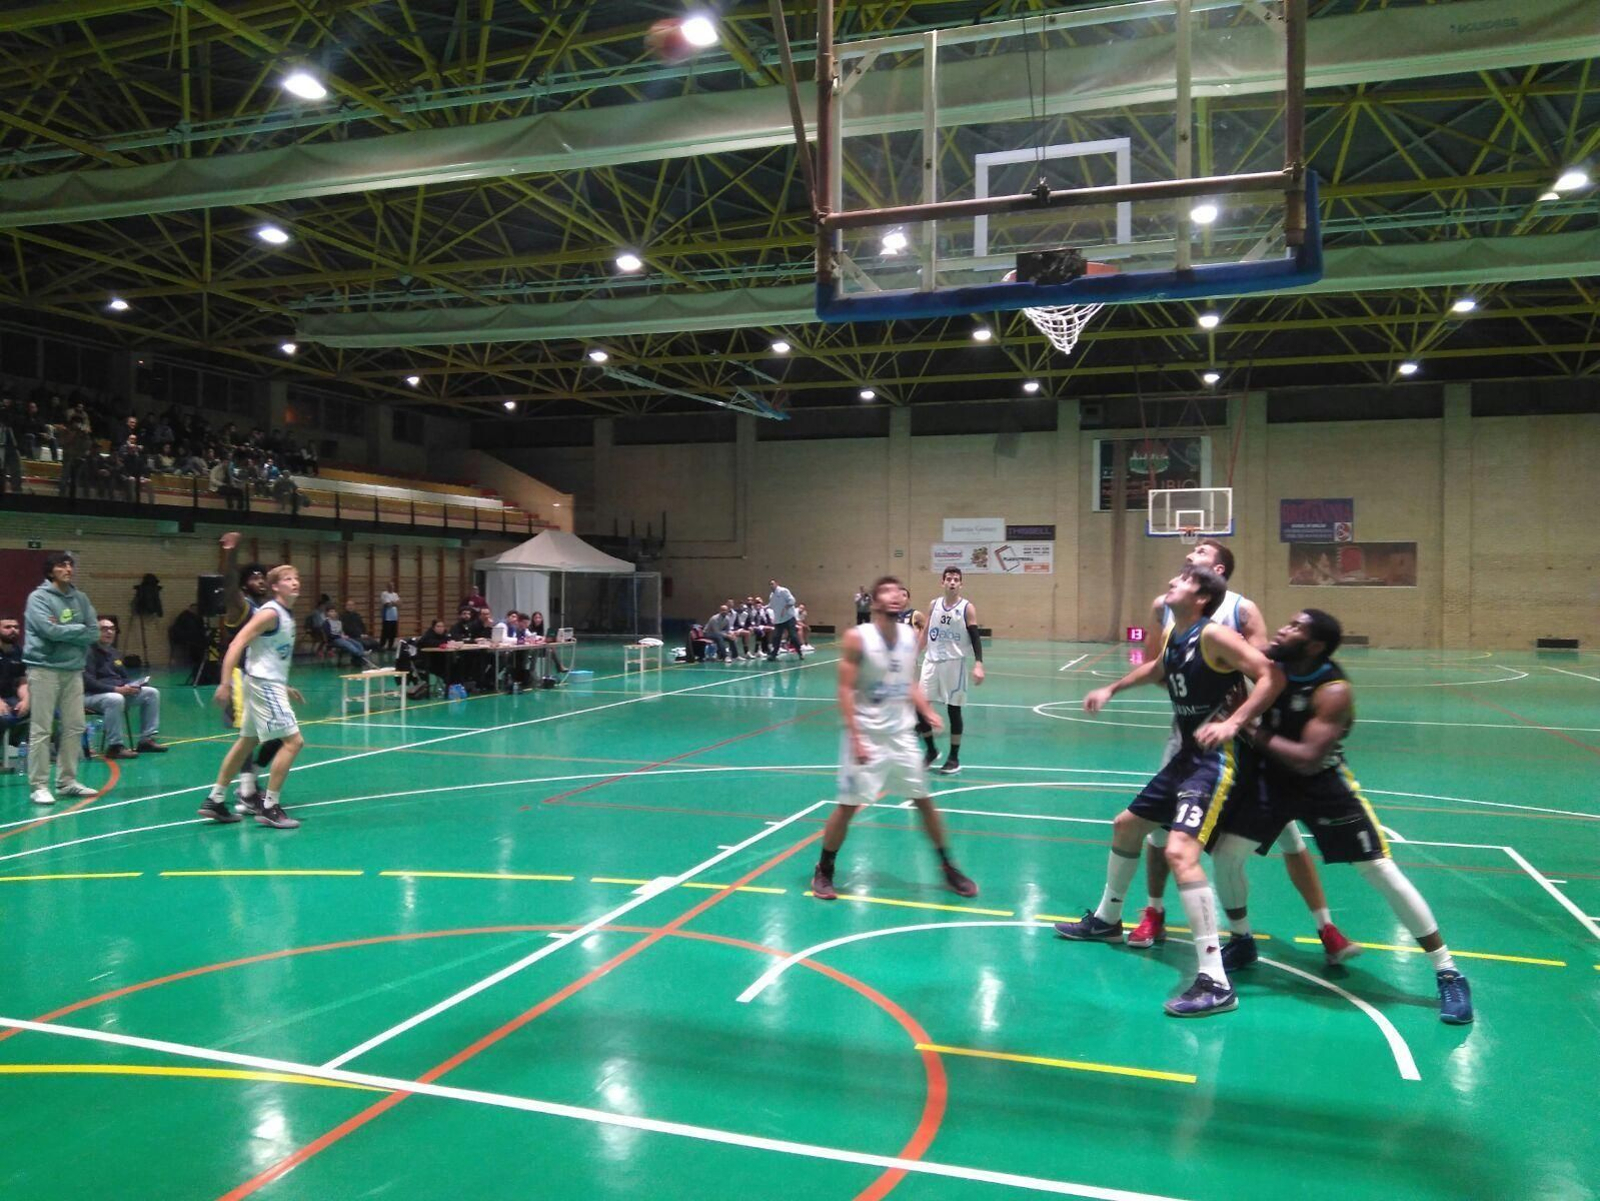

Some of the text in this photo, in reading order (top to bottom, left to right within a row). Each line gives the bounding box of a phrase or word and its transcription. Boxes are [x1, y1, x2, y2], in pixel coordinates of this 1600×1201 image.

[940, 615, 952, 626] 37
[1131, 629, 1143, 640] 13
[1169, 673, 1188, 698] 13
[1175, 803, 1204, 828] 13
[1357, 830, 1372, 853] 1
